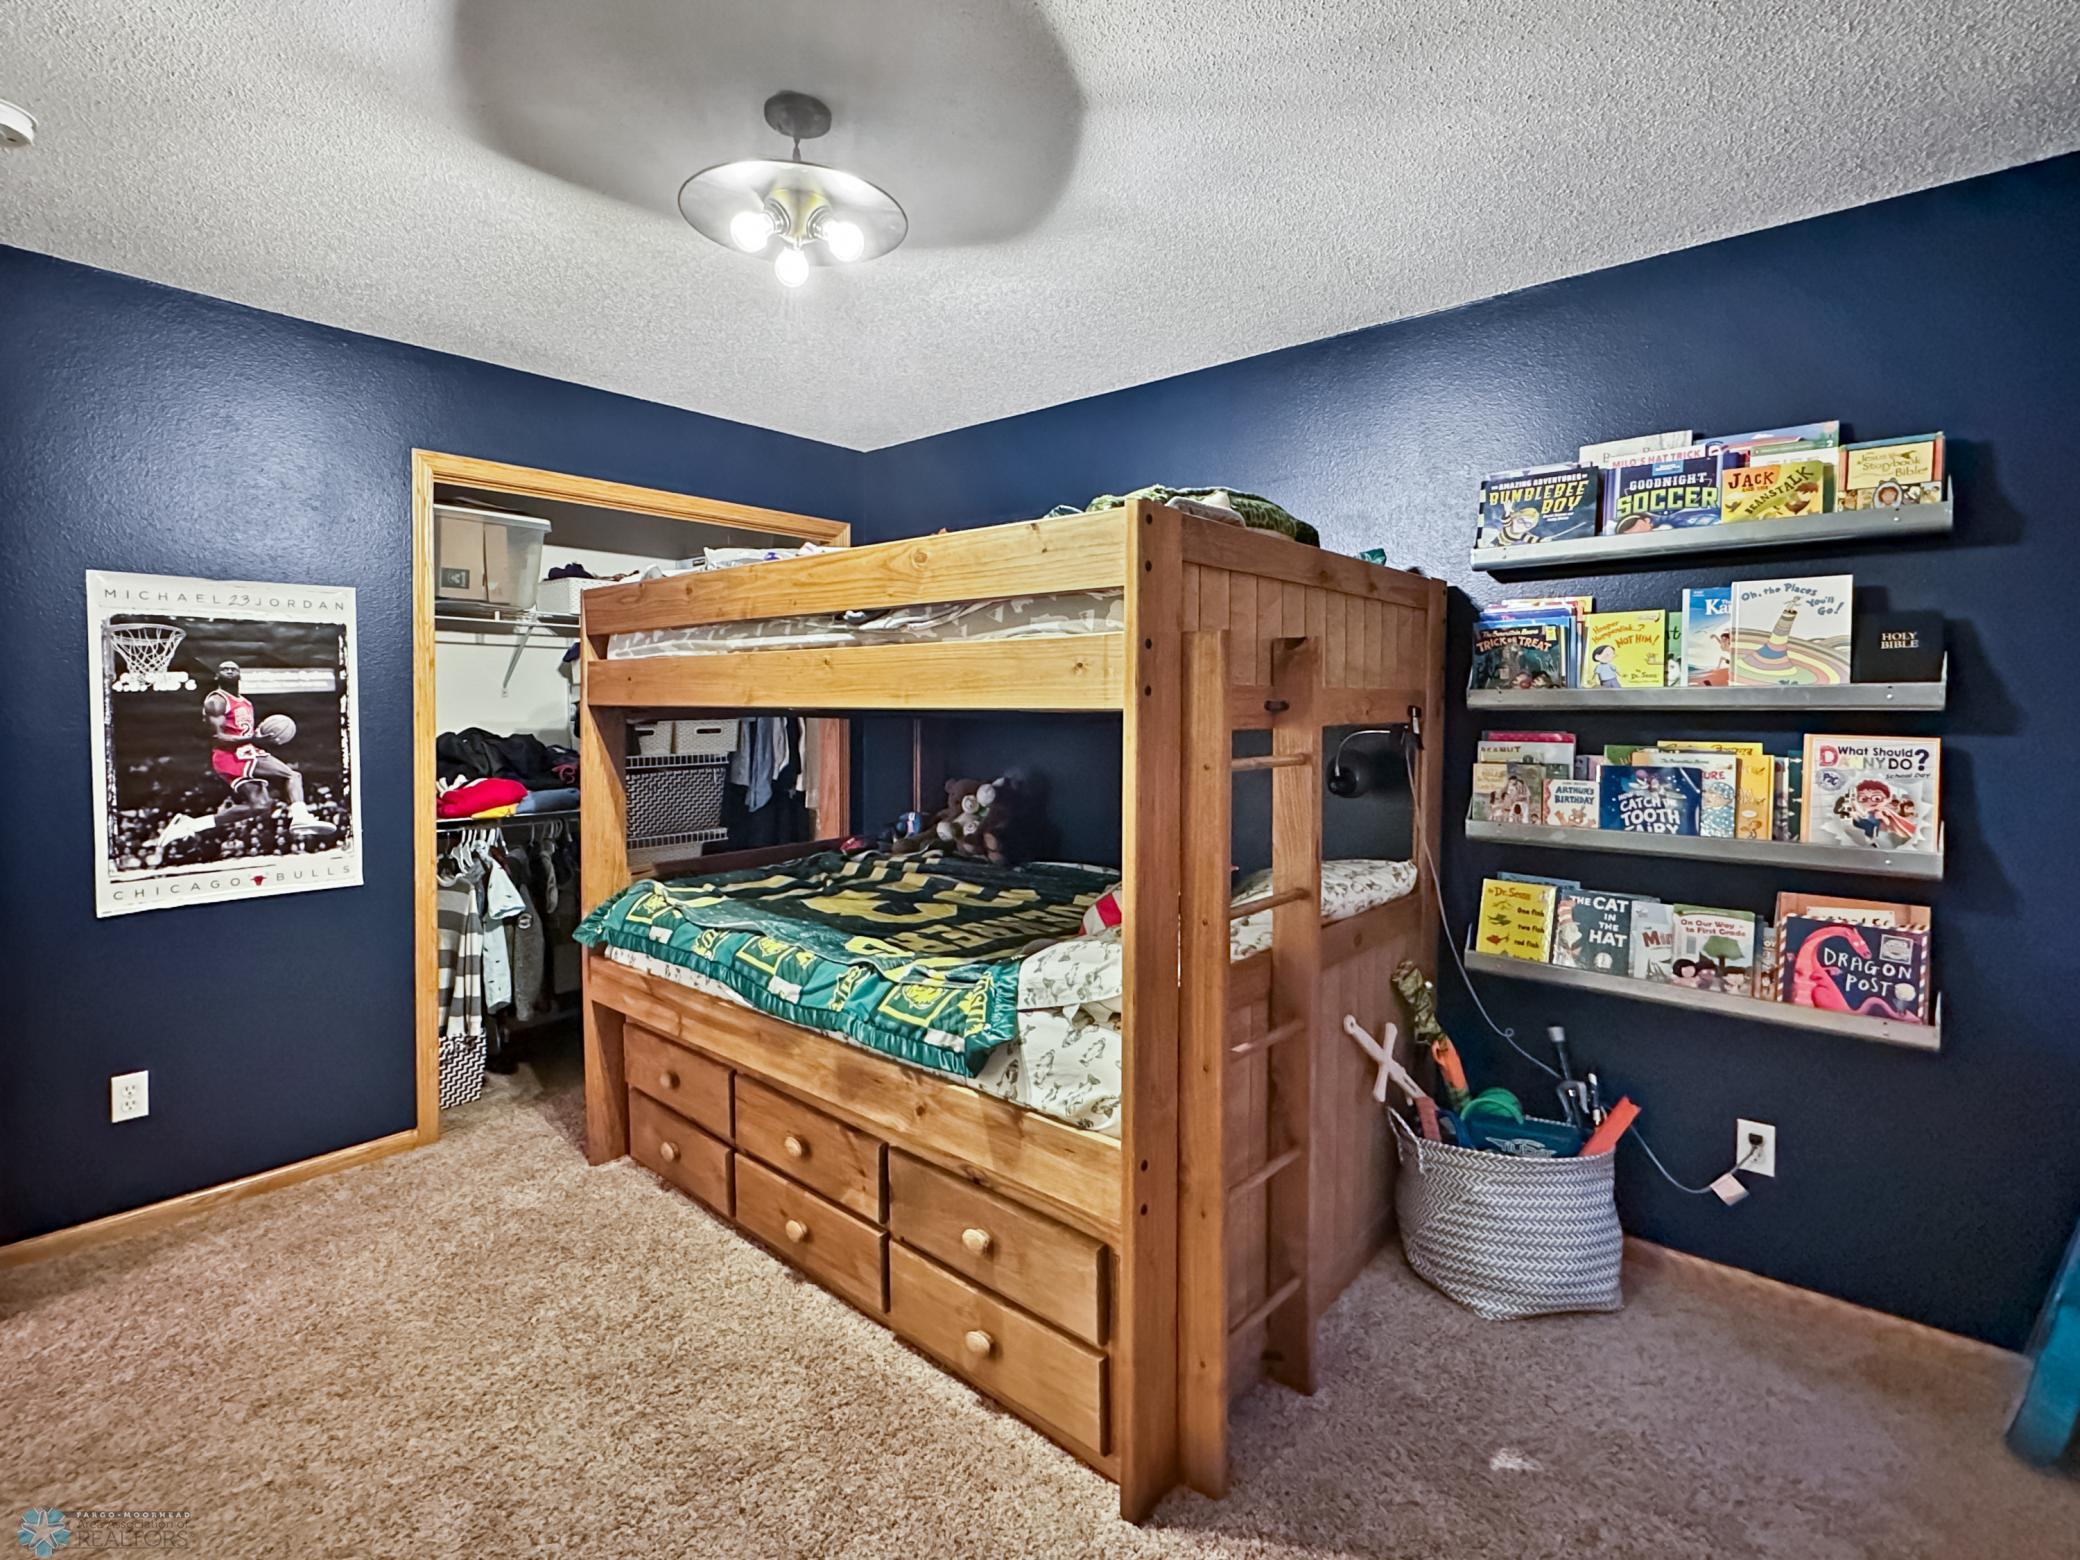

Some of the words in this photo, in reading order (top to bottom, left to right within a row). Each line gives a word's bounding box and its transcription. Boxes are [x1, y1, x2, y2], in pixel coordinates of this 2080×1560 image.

[1647, 453, 1668, 464] HAT
[1671, 449, 1701, 461] TRICK
[1629, 472, 1708, 491] GOODNIGHT
[1727, 471, 1776, 489] JACK
[1489, 480, 1589, 506] BUMBLEBEE
[1744, 466, 1815, 514] BEANSTALK
[1541, 495, 1582, 514] BOY
[1616, 486, 1718, 519] SOCCER
[1784, 583, 1817, 596] Places
[104, 589, 221, 605] MICHAEL
[227, 594, 251, 607] 23
[255, 600, 345, 612] JORDAN
[1817, 602, 1845, 616] Go!
[1476, 637, 1508, 652] TRICK
[1518, 636, 1552, 652] TREAT
[1615, 634, 1635, 648] NOT
[1880, 639, 1919, 650] BIBLE
[1881, 632, 1918, 641] HOLY
[1838, 746, 1868, 756] What
[1873, 747, 1913, 758] Should
[1554, 795, 1595, 805] BIRTHDAY
[1620, 797, 1661, 811] CATCH
[1620, 808, 1681, 826] TOOTH
[113, 877, 241, 901] CHICAGO
[276, 865, 351, 881] BULLS
[1569, 895, 1591, 906] THE
[1592, 896, 1629, 913] CAT
[1604, 913, 1616, 921] IN
[1681, 918, 1693, 926] On
[1714, 921, 1735, 930] Way
[1599, 922, 1619, 932] THE
[1589, 929, 1627, 948] HAT
[1823, 947, 1912, 979] DRAGON
[1845, 973, 1893, 997] POST
